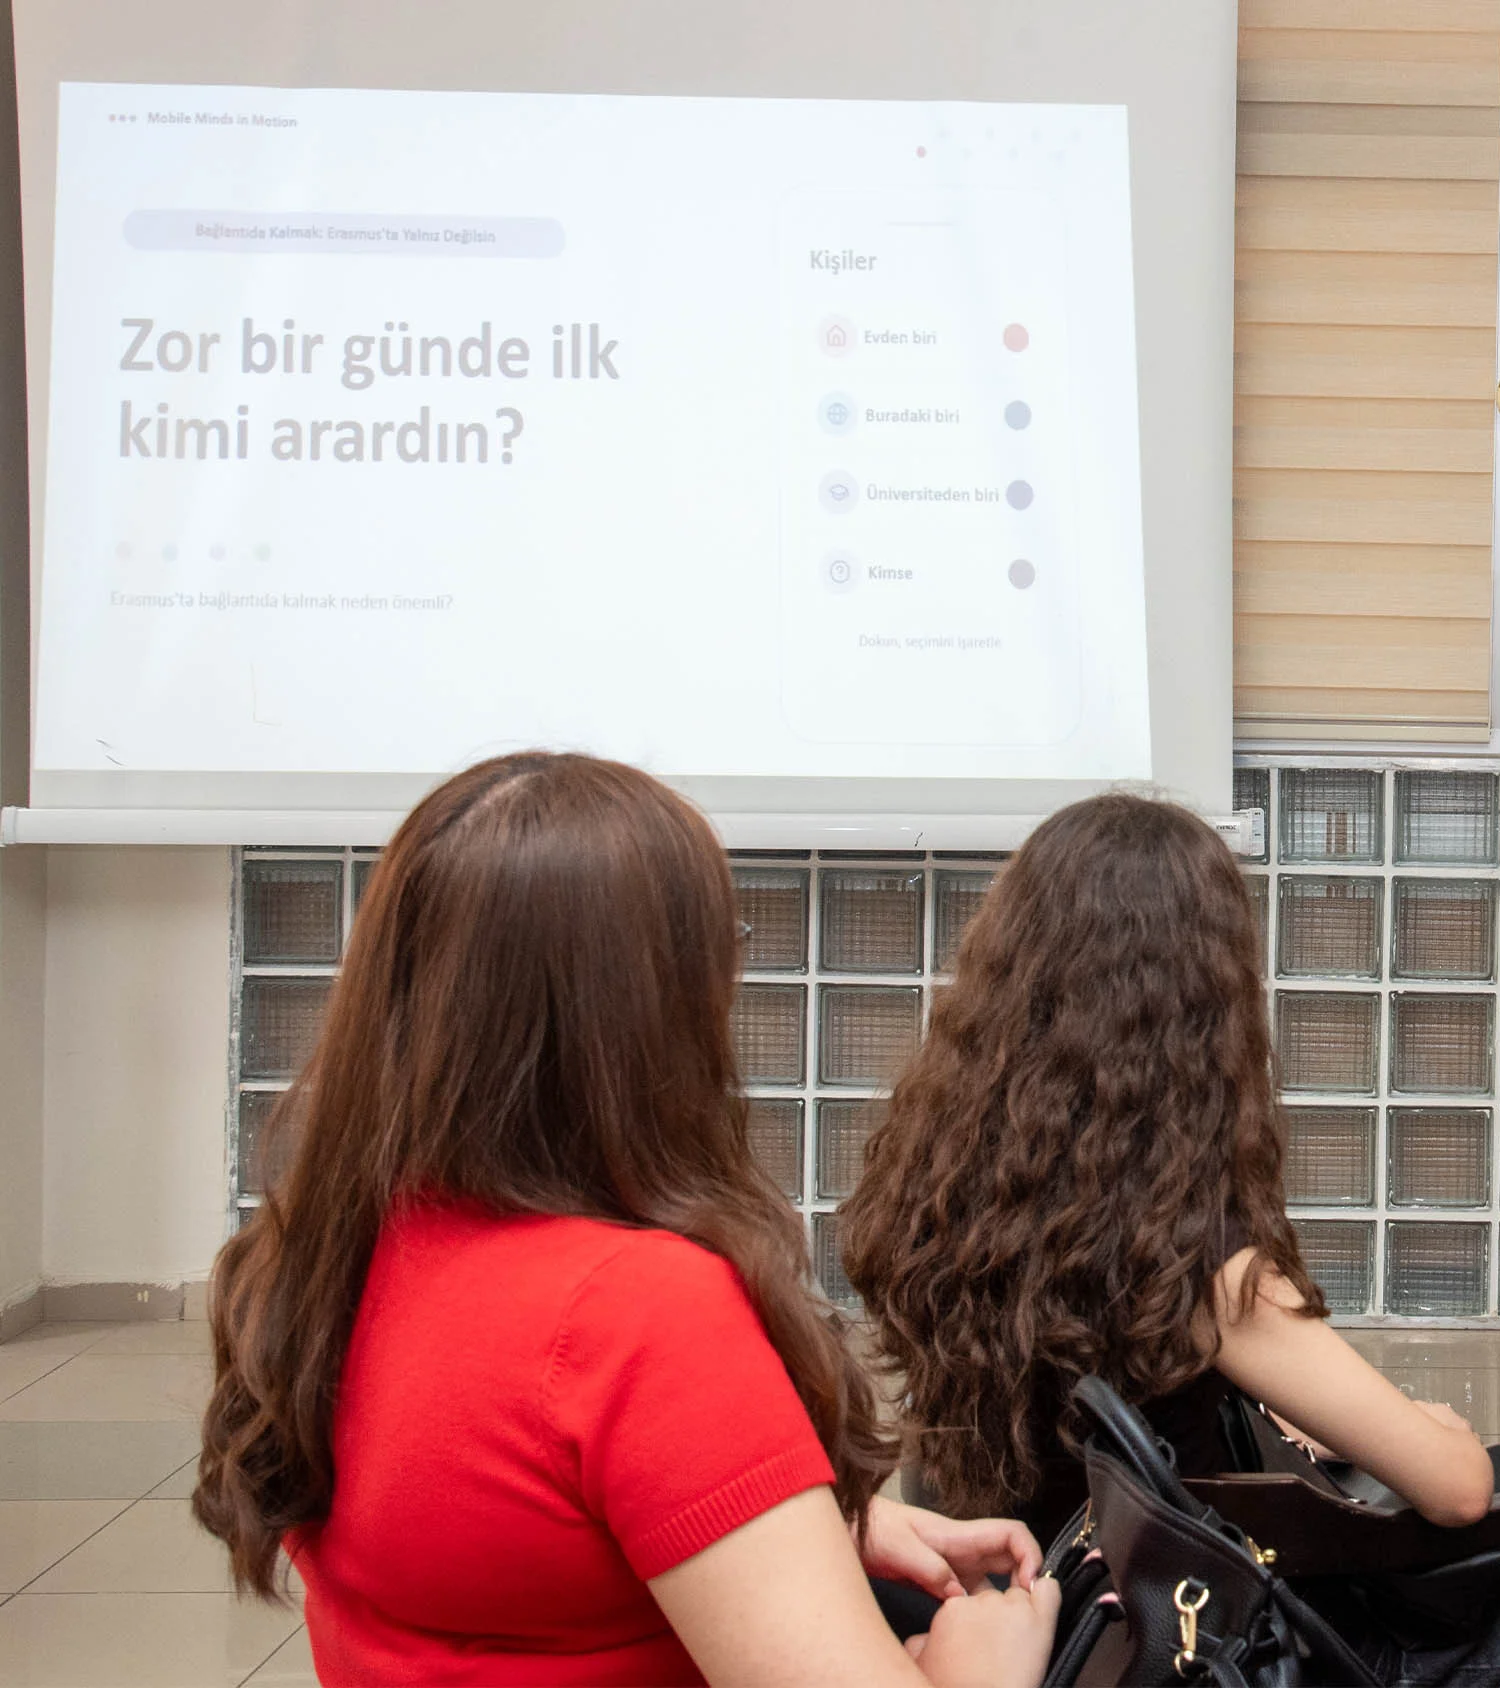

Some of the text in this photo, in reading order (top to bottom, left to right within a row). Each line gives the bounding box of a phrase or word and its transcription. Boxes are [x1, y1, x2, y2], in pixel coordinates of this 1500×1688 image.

[147, 111, 298, 129] Mobile Minds in Motion
[268, 224, 323, 240] Kalmak:
[327, 226, 399, 242] Erasmus'ta
[402, 228, 440, 243] Yalnız
[809, 249, 877, 275] Kişiler
[863, 329, 937, 346] Evden biri
[119, 317, 620, 391] Zor bir günde ilk
[865, 406, 960, 424] Buradaki biri
[119, 400, 524, 465] kimi arardın?
[866, 484, 1000, 503] Üniversiteden biri
[867, 565, 913, 581] Kimse
[110, 590, 454, 611] Erasmus'ta bağlantıda kalmak neden önemli?
